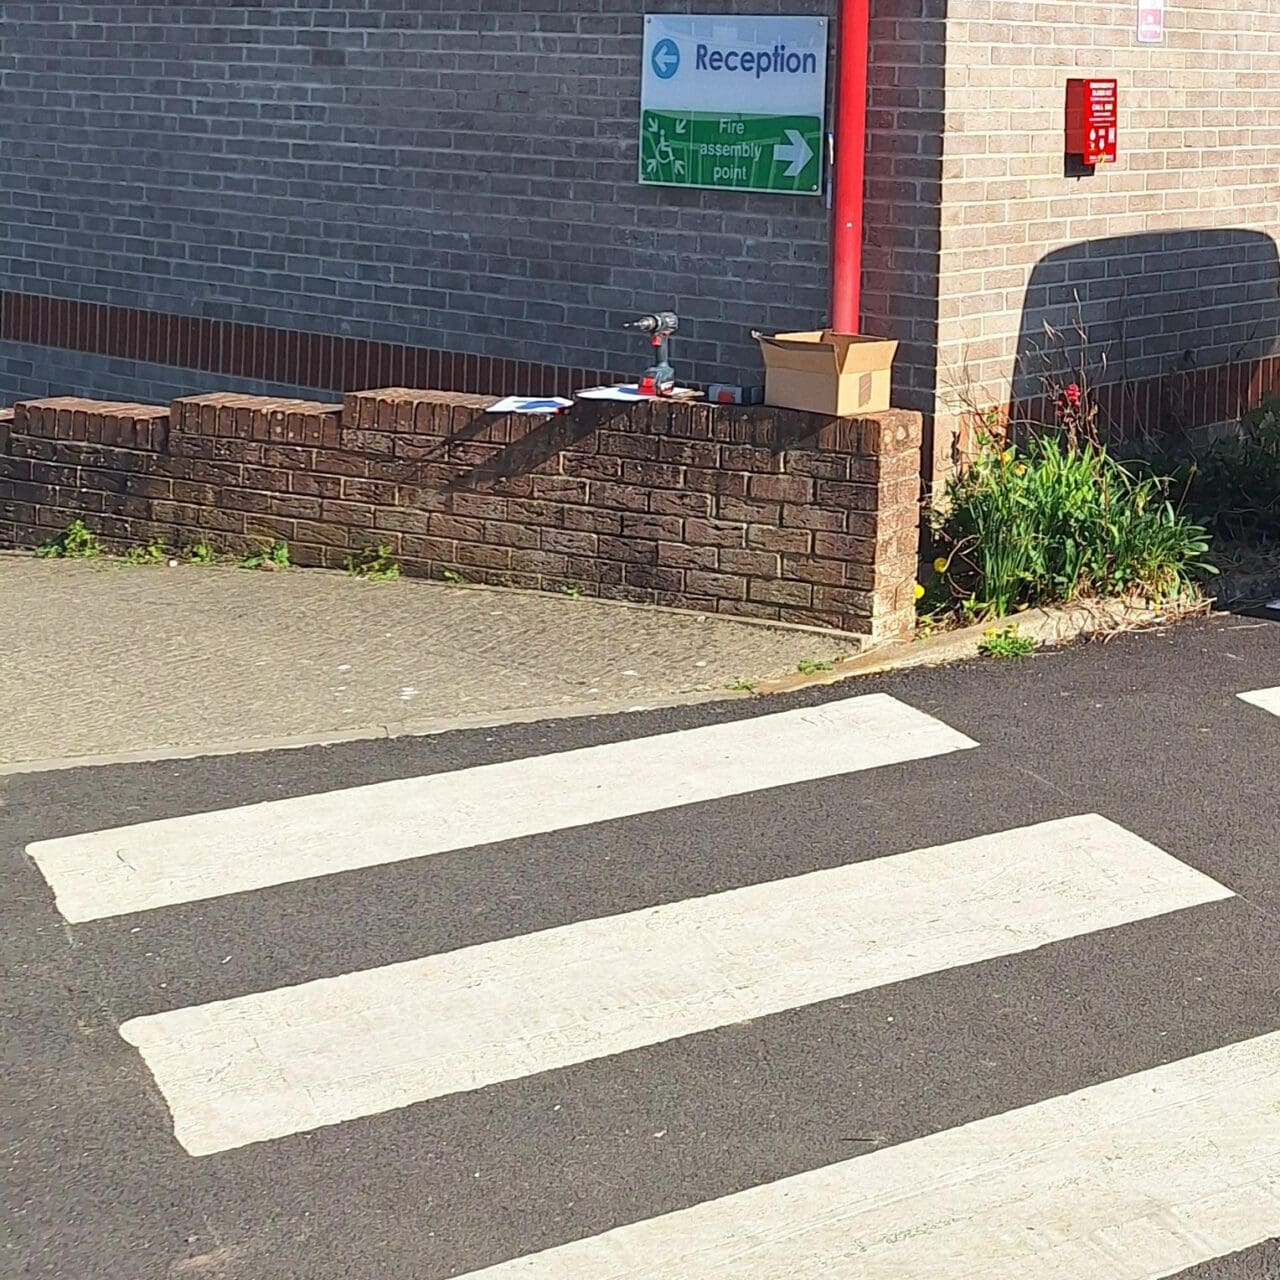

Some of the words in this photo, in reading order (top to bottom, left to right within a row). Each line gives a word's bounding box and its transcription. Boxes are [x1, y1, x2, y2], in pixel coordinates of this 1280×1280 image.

[695, 43, 817, 79] Reception
[719, 118, 745, 134] Fire
[700, 142, 762, 162] assembly
[713, 165, 747, 182] point
